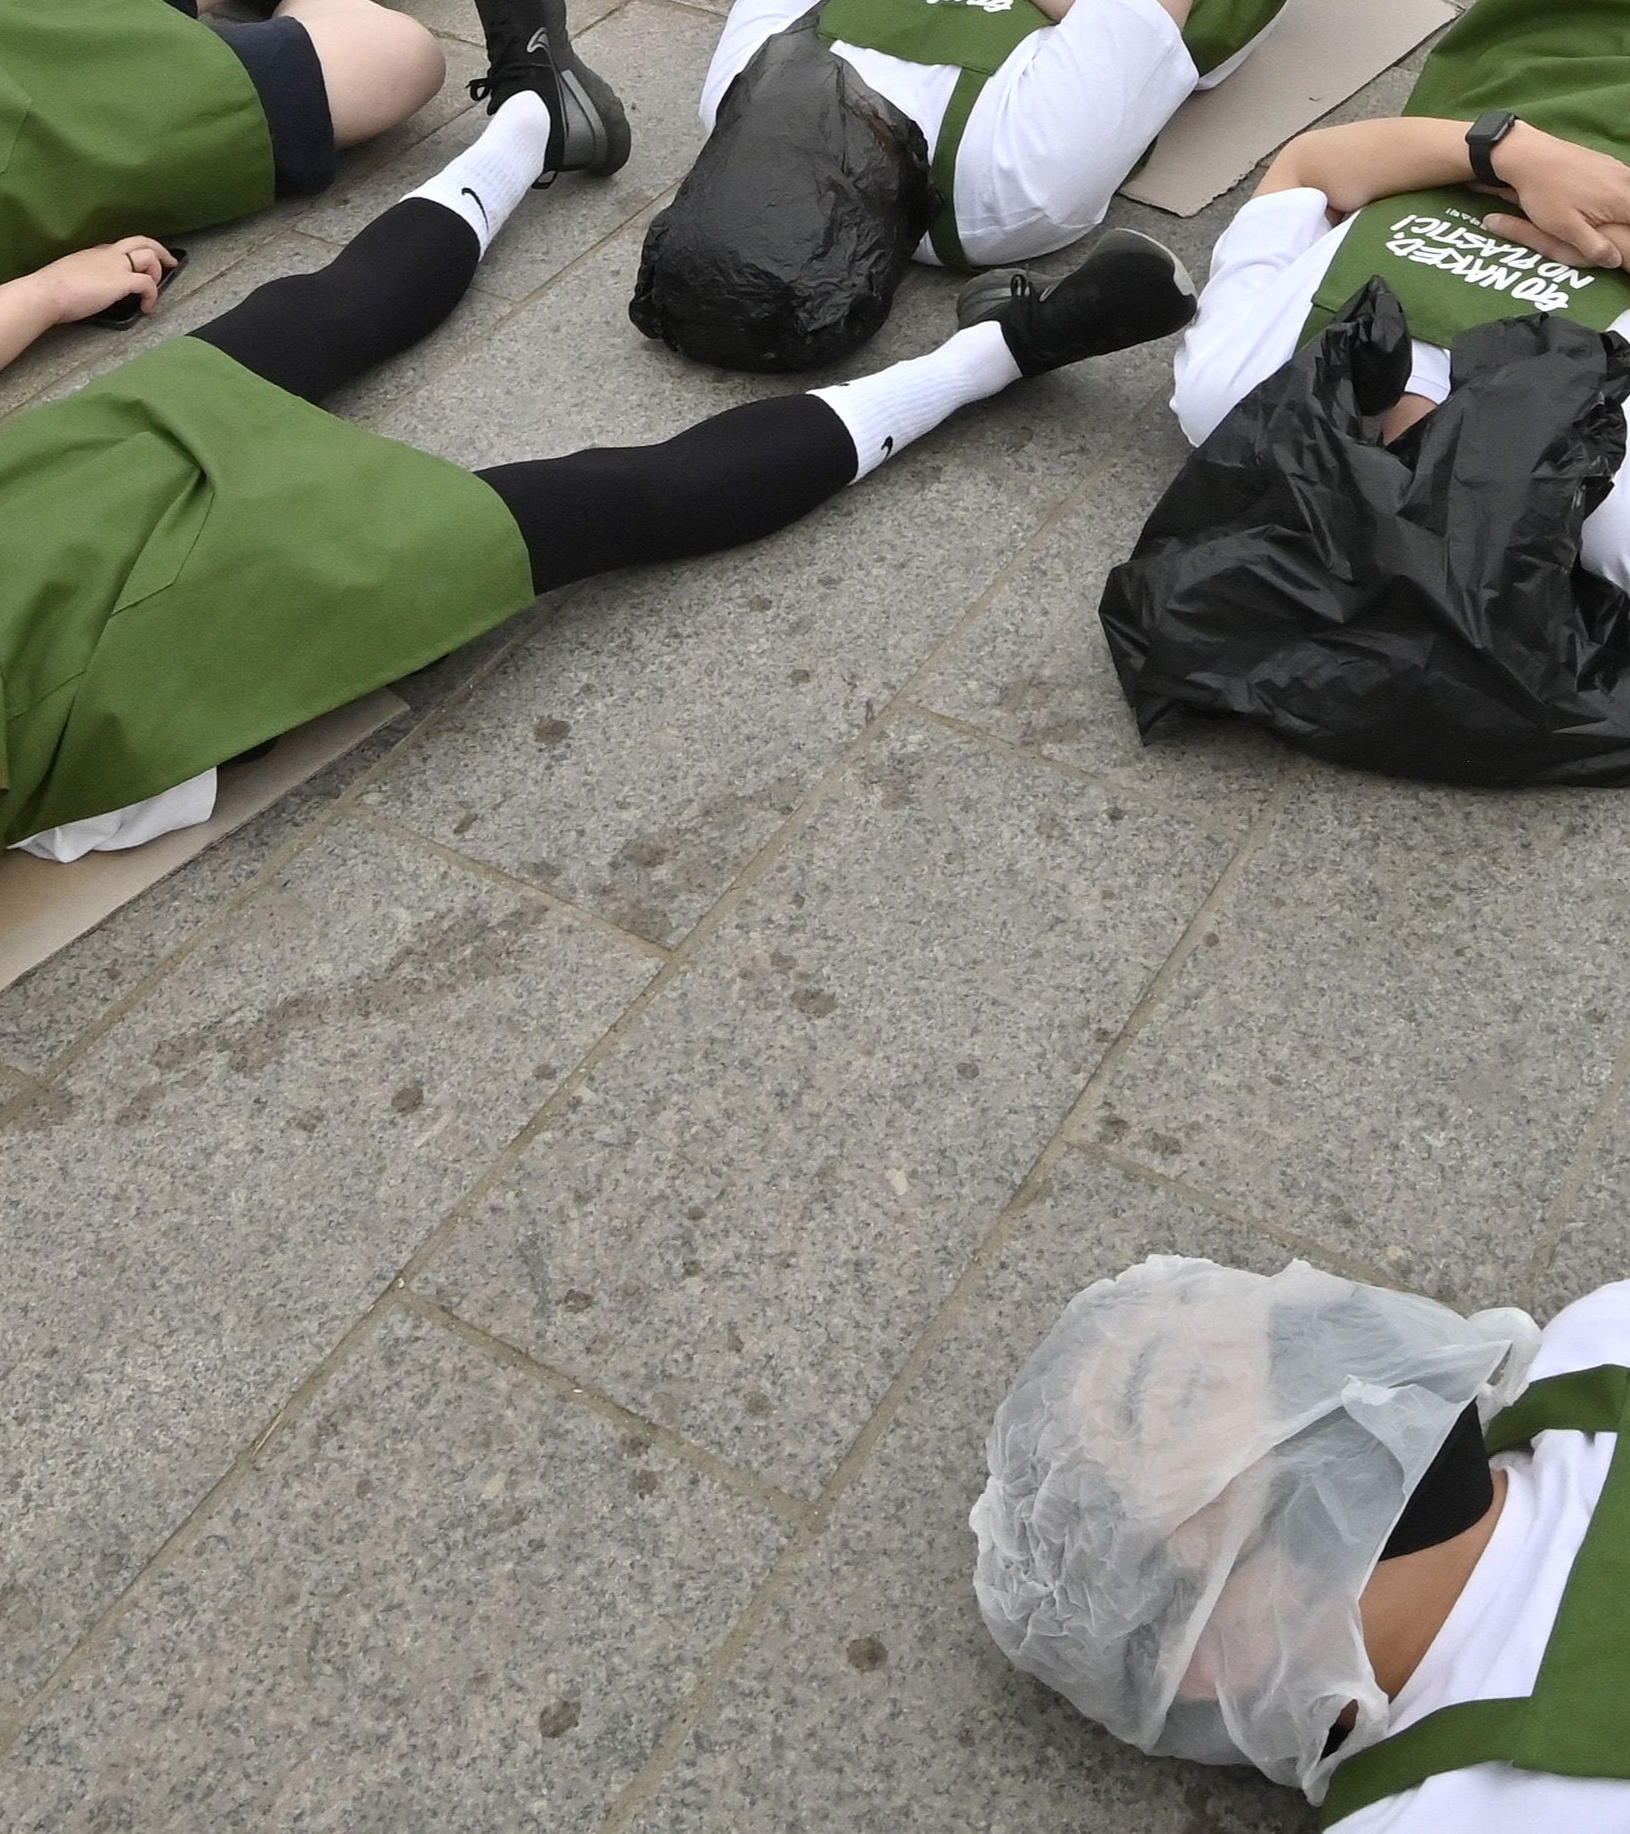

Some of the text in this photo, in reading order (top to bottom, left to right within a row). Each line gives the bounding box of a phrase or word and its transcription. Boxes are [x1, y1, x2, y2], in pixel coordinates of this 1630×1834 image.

[1385, 230, 1569, 312] GO NAKED,
[1390, 214, 1596, 289] NO PLASTIC!
